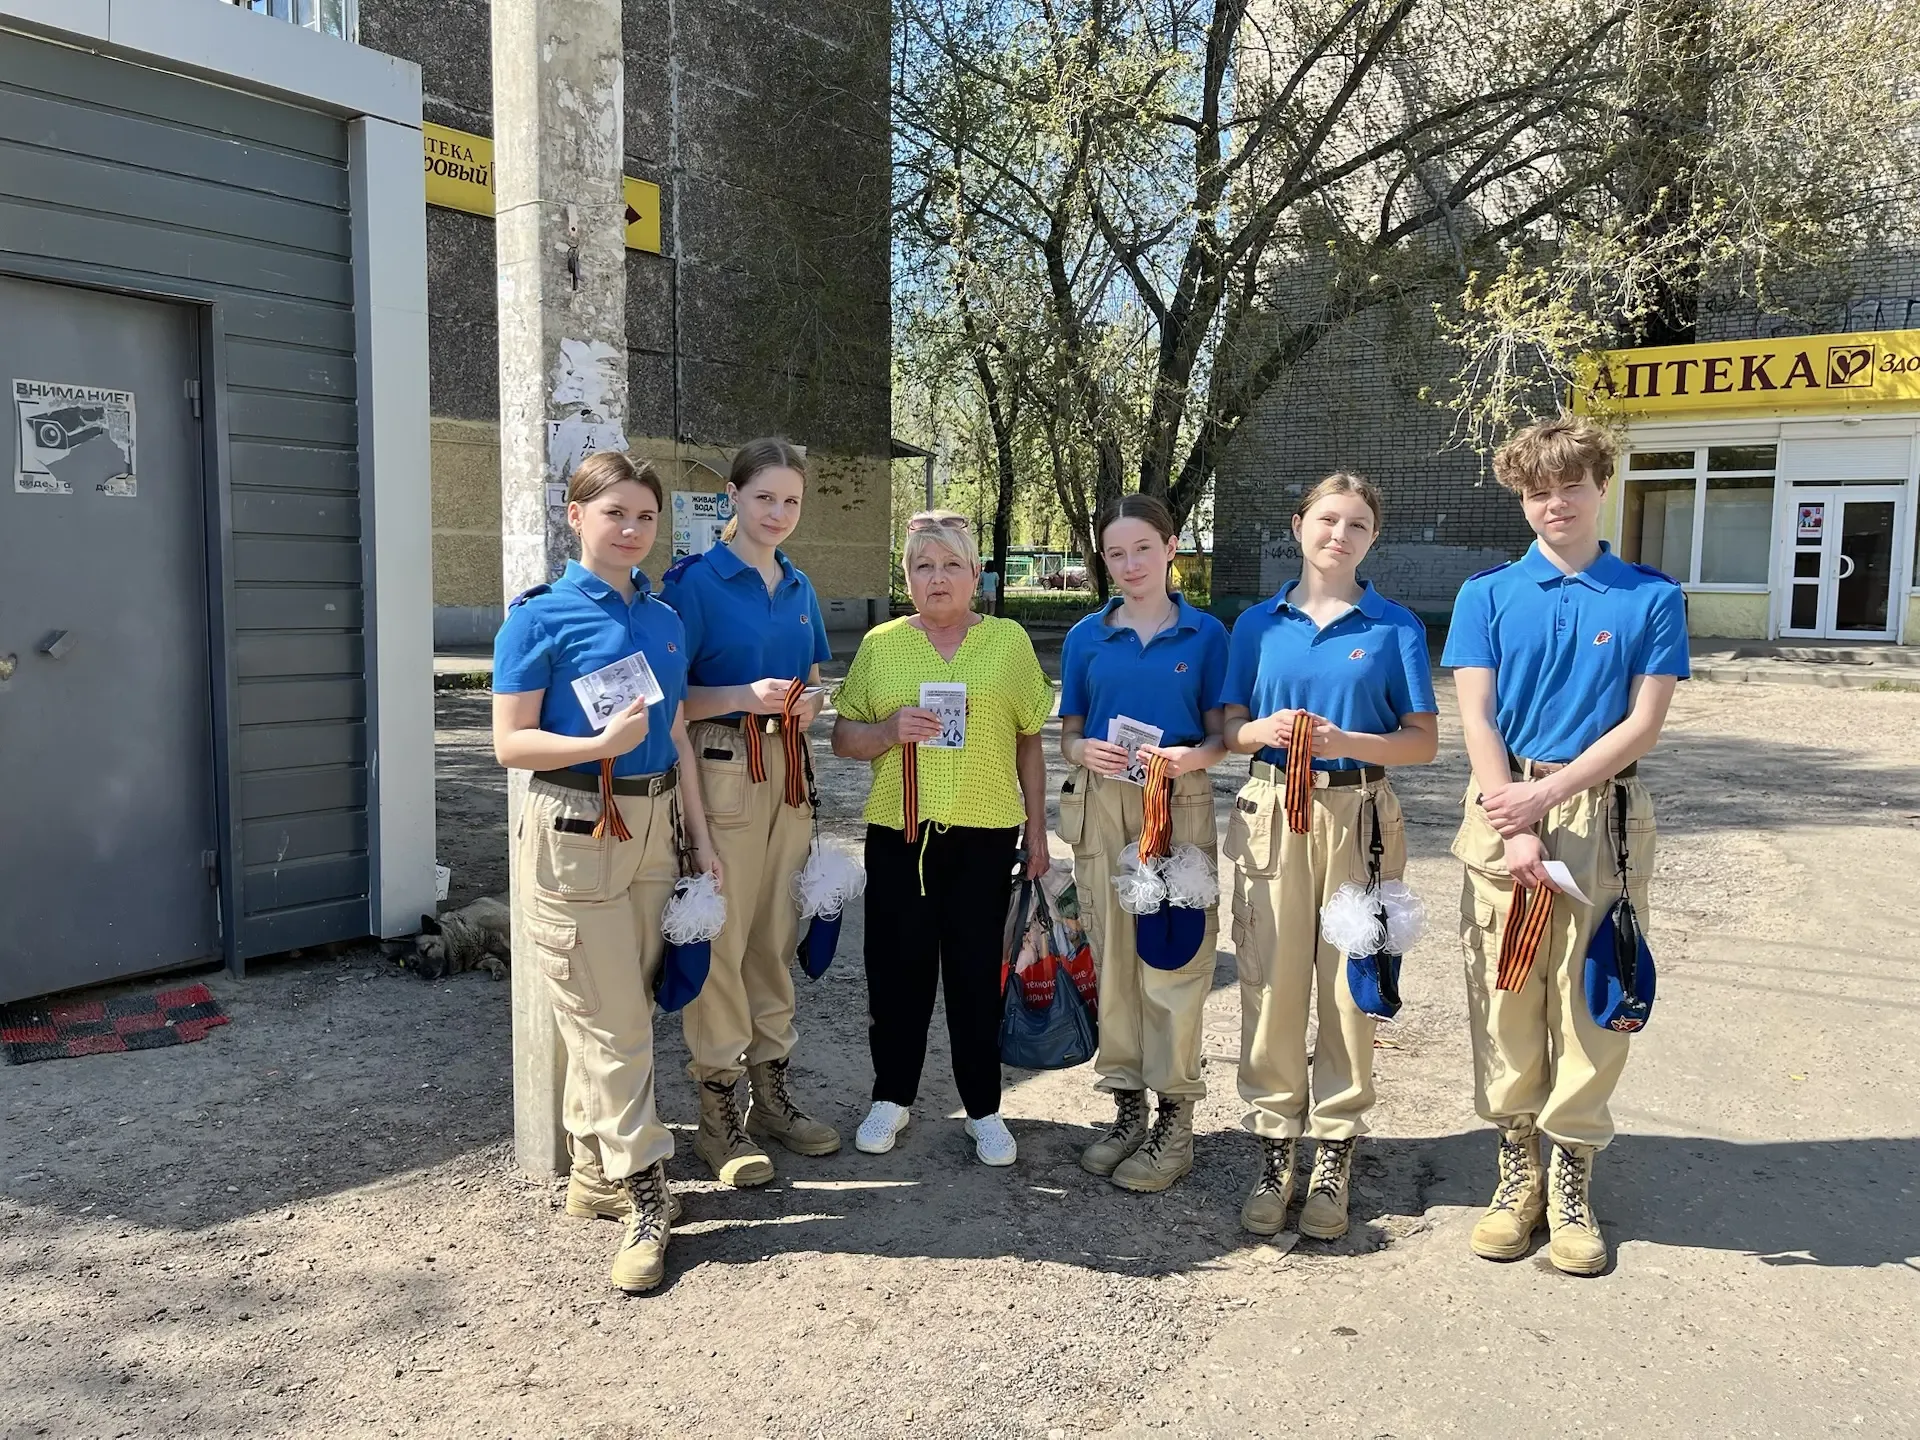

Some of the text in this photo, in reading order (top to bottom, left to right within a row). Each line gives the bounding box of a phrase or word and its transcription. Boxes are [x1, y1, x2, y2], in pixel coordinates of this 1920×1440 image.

[1587, 351, 1820, 399] АПТЕКА
[16, 382, 130, 403] ВНИМАНИЕ!
[691, 495, 717, 504] ЖИВАЯ
[694, 503, 714, 512] ВОДА
